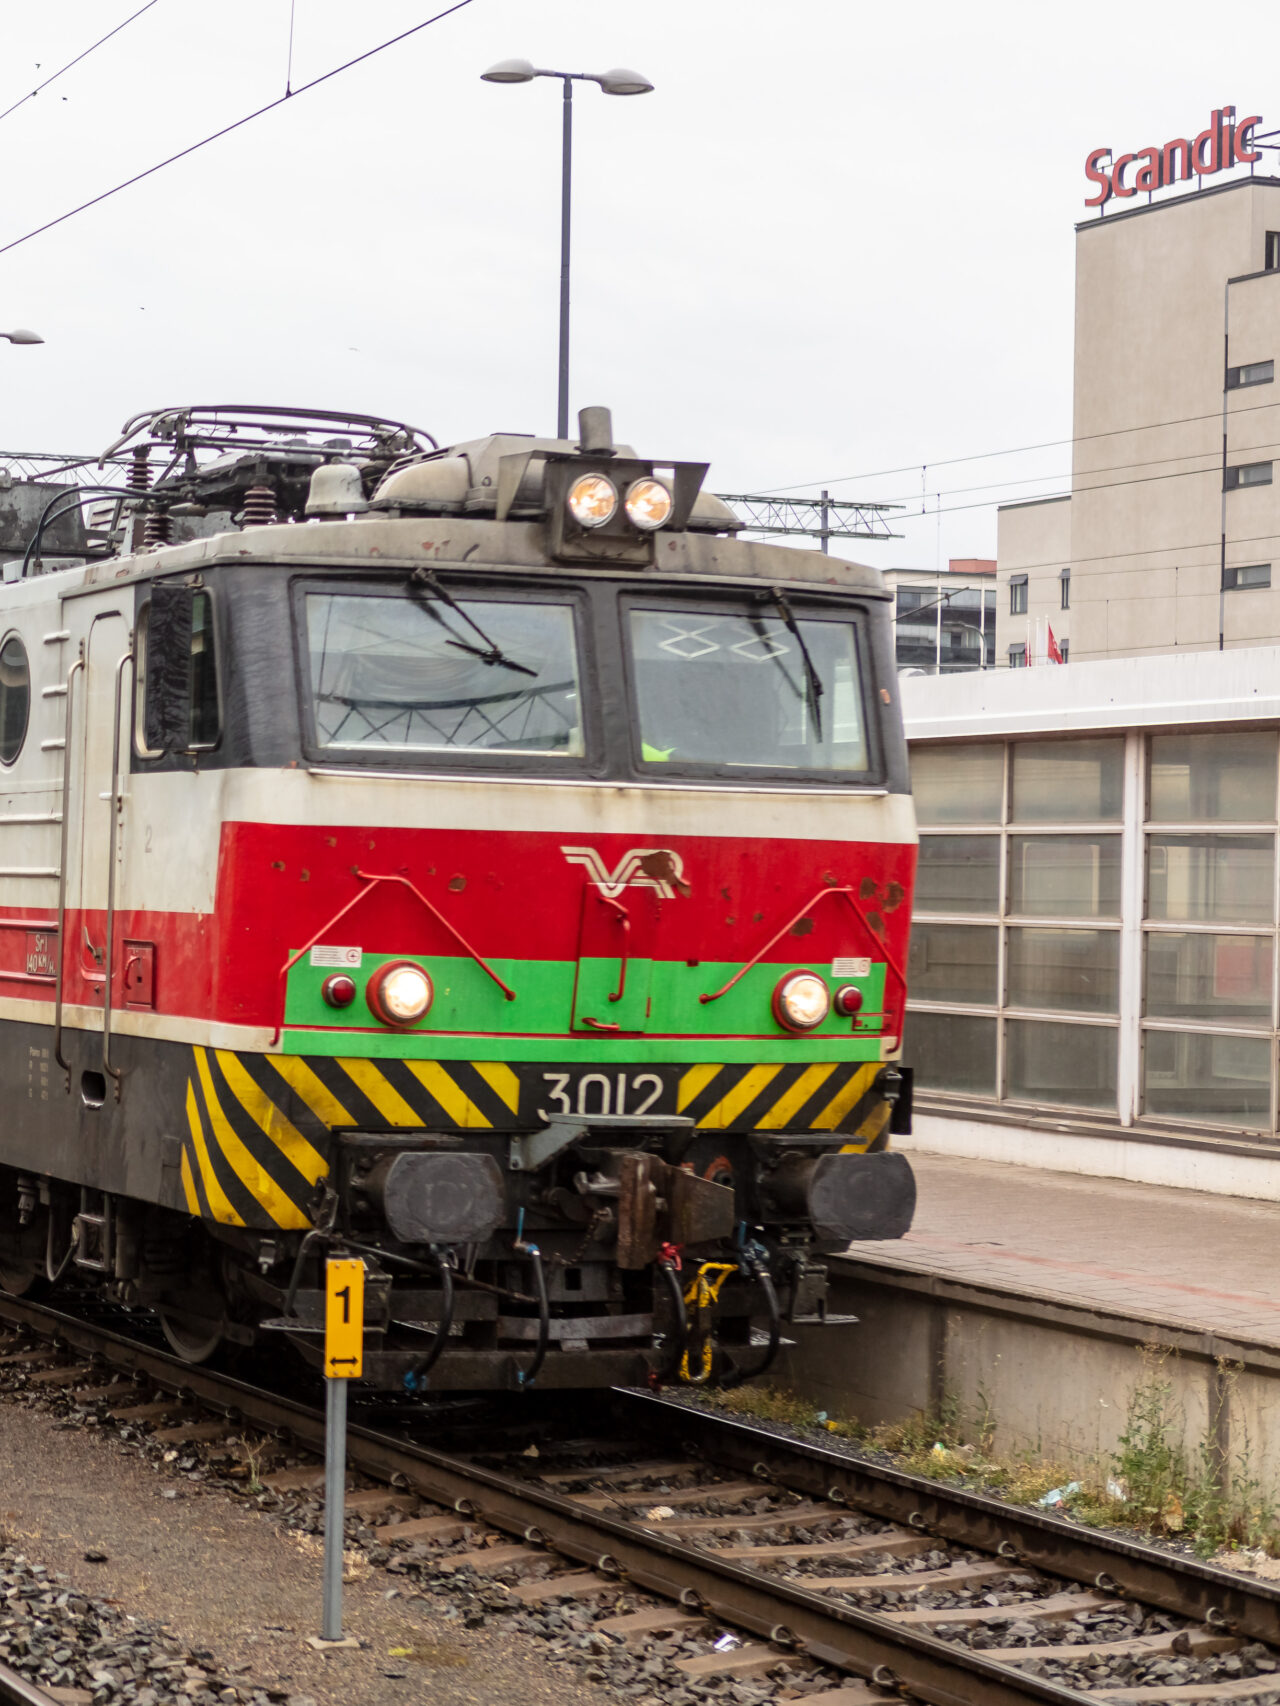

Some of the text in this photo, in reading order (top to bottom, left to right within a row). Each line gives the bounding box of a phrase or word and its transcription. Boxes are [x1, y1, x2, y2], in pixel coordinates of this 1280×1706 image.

[1084, 105, 1263, 208] Scandic
[560, 846, 685, 899] VR
[537, 1072, 664, 1123] 3012
[335, 1285, 350, 1324] 1
